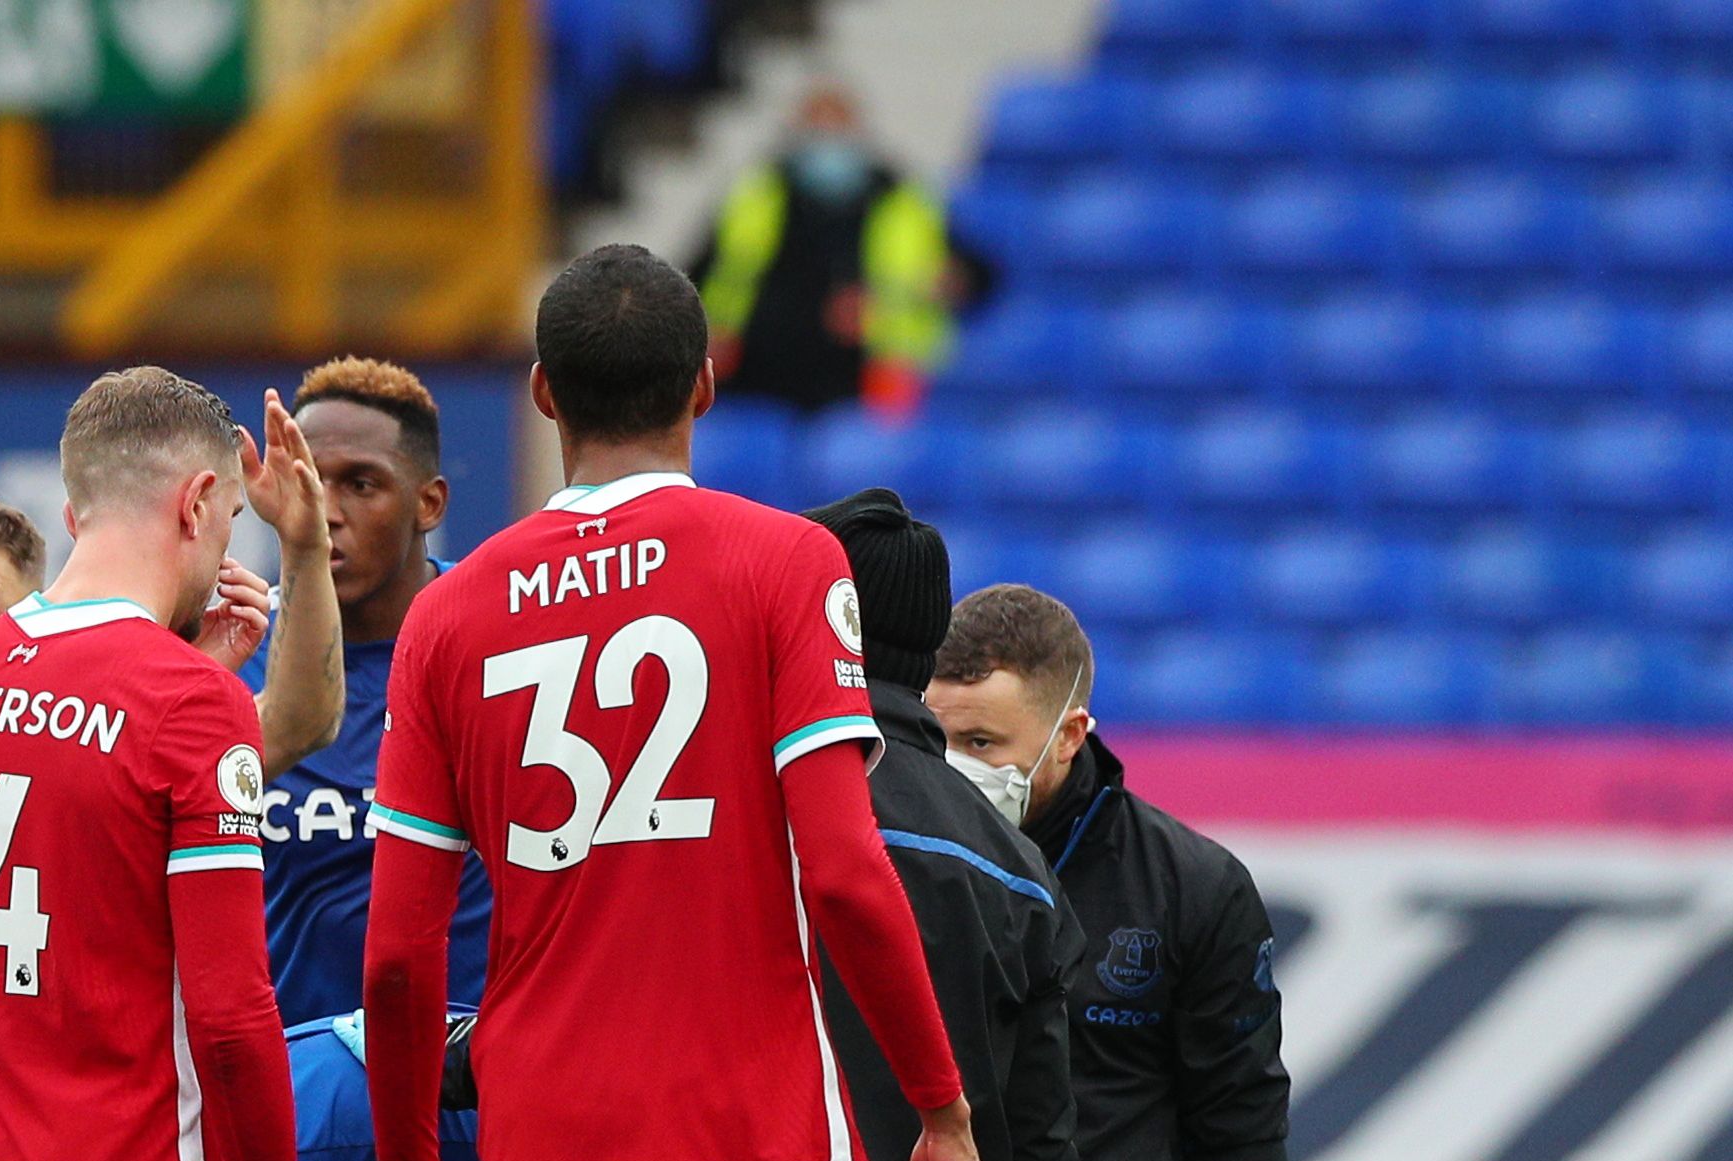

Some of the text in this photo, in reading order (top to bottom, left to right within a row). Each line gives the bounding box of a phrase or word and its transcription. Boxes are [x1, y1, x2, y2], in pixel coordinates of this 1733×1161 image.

[508, 538, 667, 613] MATIP
[482, 614, 716, 872] 32
[1085, 1005, 1161, 1026] CAZOO
